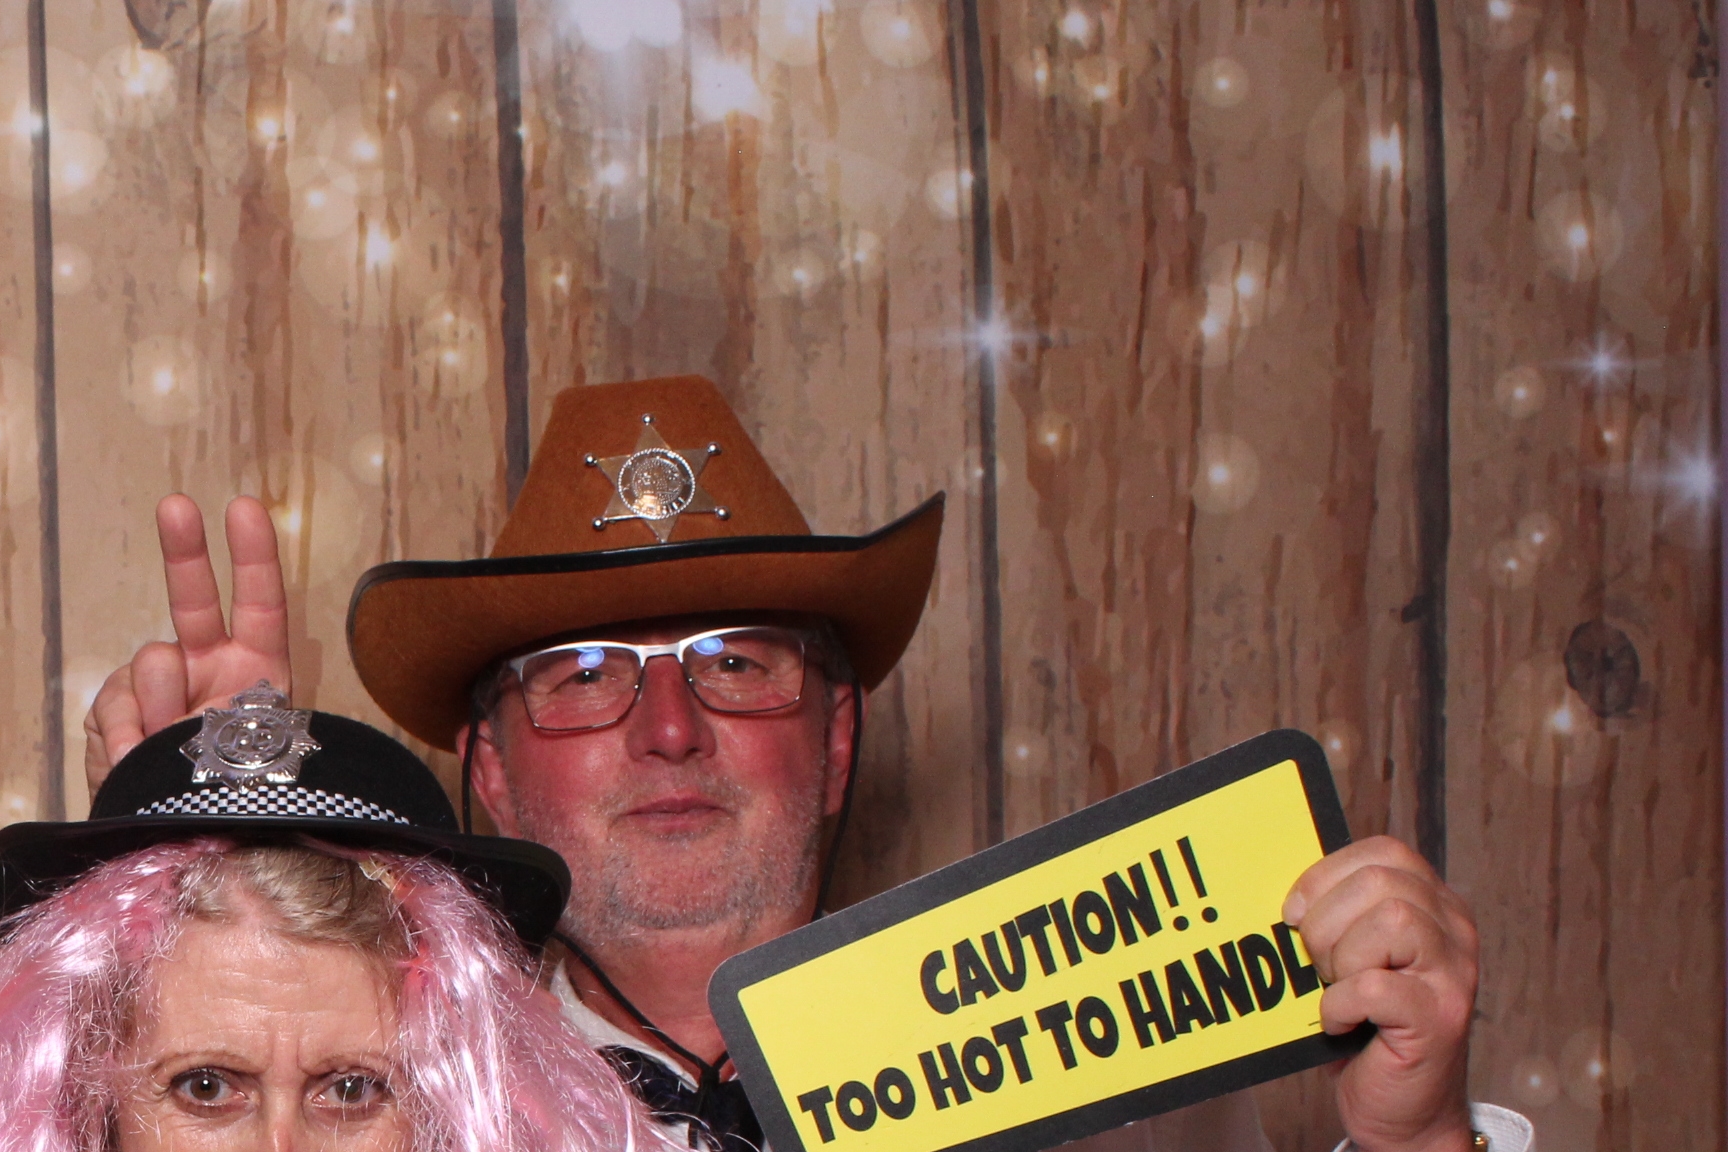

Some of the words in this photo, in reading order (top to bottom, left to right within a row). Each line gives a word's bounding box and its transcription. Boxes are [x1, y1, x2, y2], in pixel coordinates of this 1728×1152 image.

[921, 836, 1218, 1014] CAUTION!!
[798, 1067, 916, 1144] TOO
[919, 1016, 1031, 1110] HOT
[1041, 996, 1119, 1071] TO
[1119, 920, 1332, 1049] HANDL
